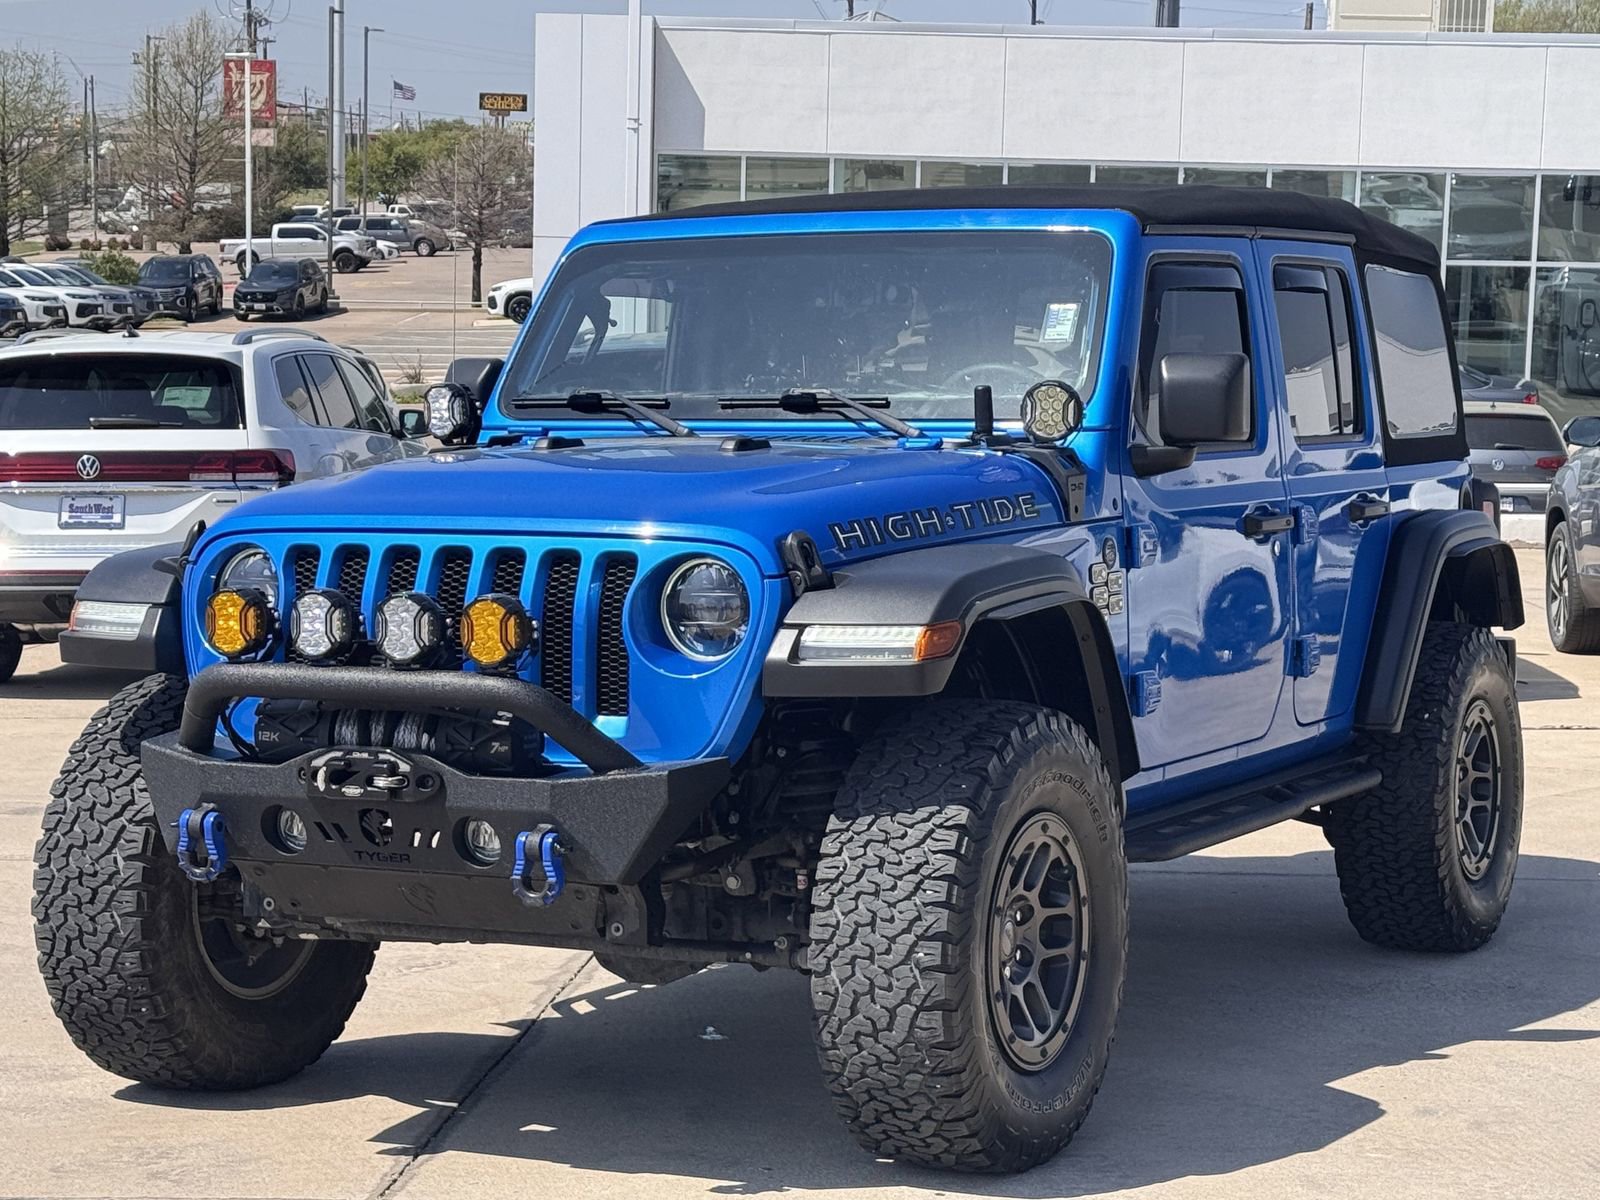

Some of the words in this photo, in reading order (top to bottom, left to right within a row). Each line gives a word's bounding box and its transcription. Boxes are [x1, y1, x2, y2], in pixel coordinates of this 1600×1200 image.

[484, 95, 523, 104] GOLDEN
[829, 507, 944, 550] HIGH
[949, 492, 1040, 530] TIDE
[258, 731, 280, 742] 12K
[353, 850, 411, 864] TYGER
